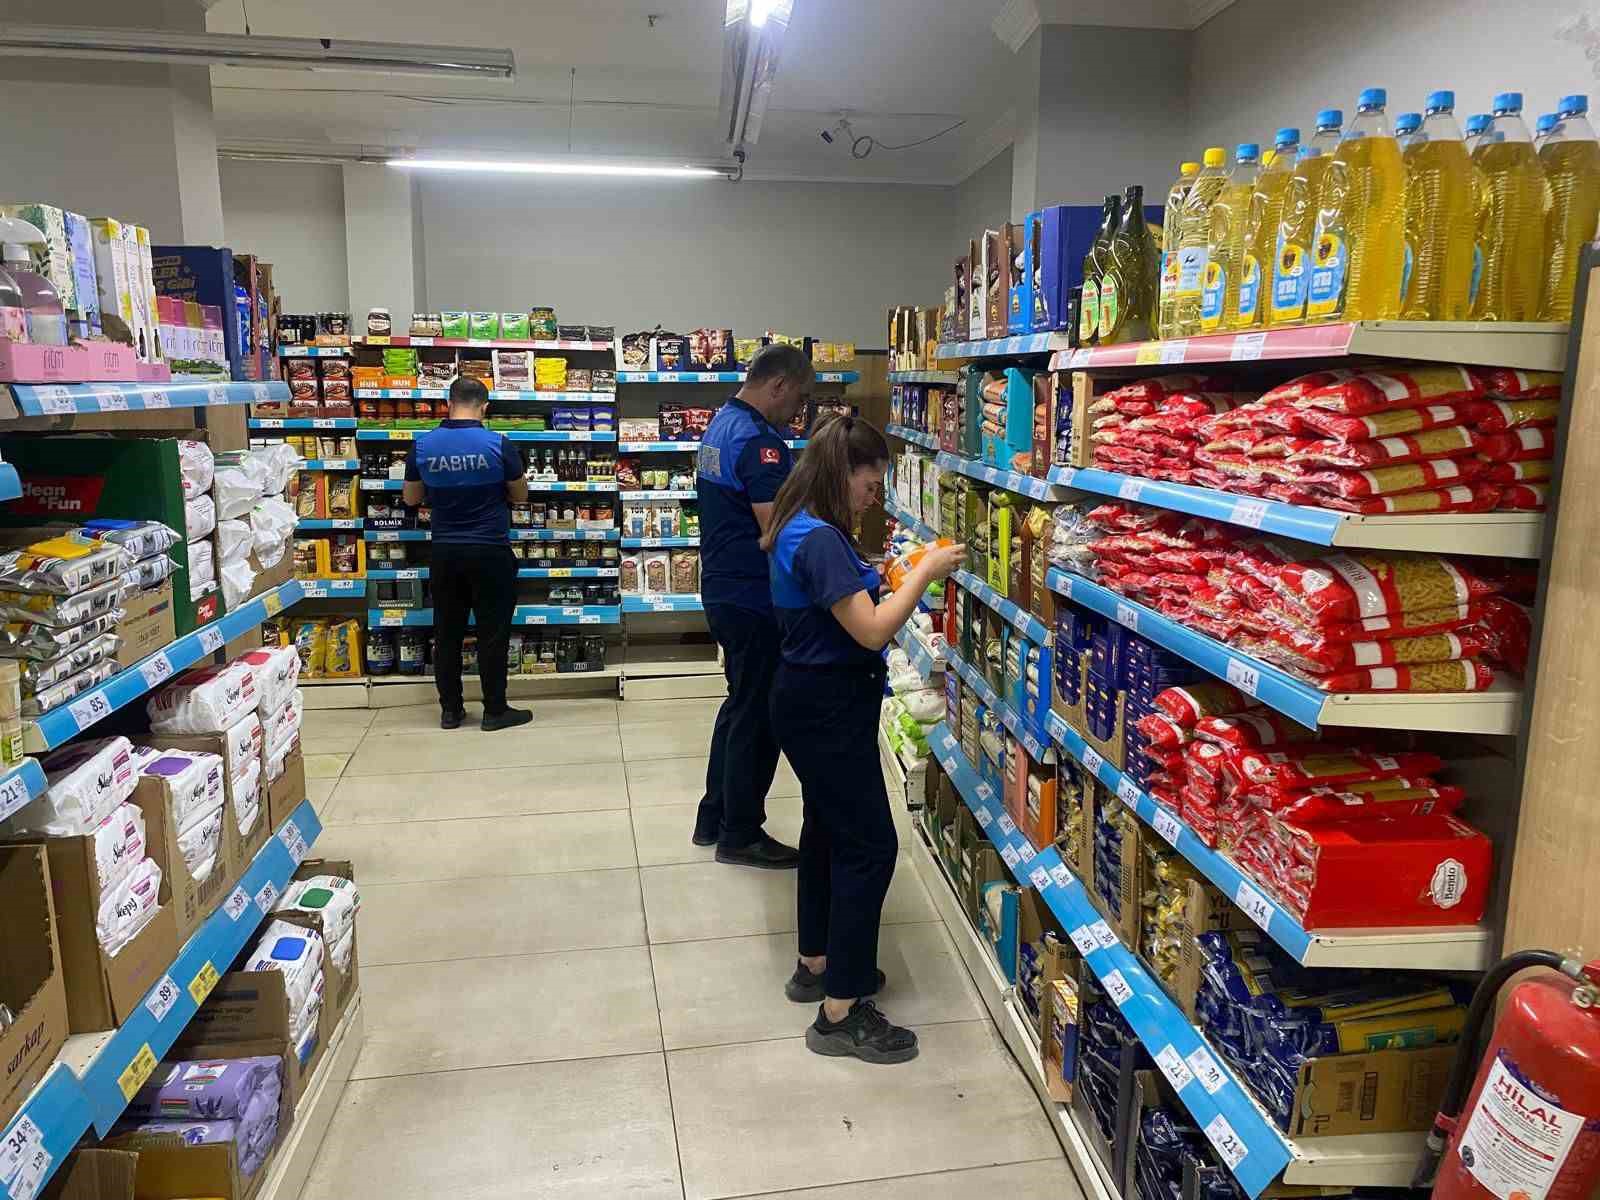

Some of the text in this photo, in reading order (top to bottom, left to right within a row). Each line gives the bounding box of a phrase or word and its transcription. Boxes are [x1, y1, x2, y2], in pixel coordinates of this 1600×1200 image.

[427, 454, 489, 473] ZABITA
[47, 497, 81, 510] Fun
[154, 658, 166, 674] 85
[1244, 670, 1254, 687] 14
[90, 696, 104, 713] 85
[1, 785, 18, 804] 21
[1167, 822, 1176, 835] 14
[1444, 866, 1456, 900] Bendo
[113, 897, 138, 918] leepy
[1255, 901, 1267, 918] 14
[159, 985, 172, 1002] 89
[1114, 983, 1126, 996] 21
[1170, 1065, 1181, 1078] 21
[1208, 1067, 1220, 1083] 30
[1498, 1075, 1562, 1129] HİLAL
[8, 1131, 27, 1154] 34
[1225, 1135, 1239, 1154] 21
[32, 1151, 43, 1171] 129
